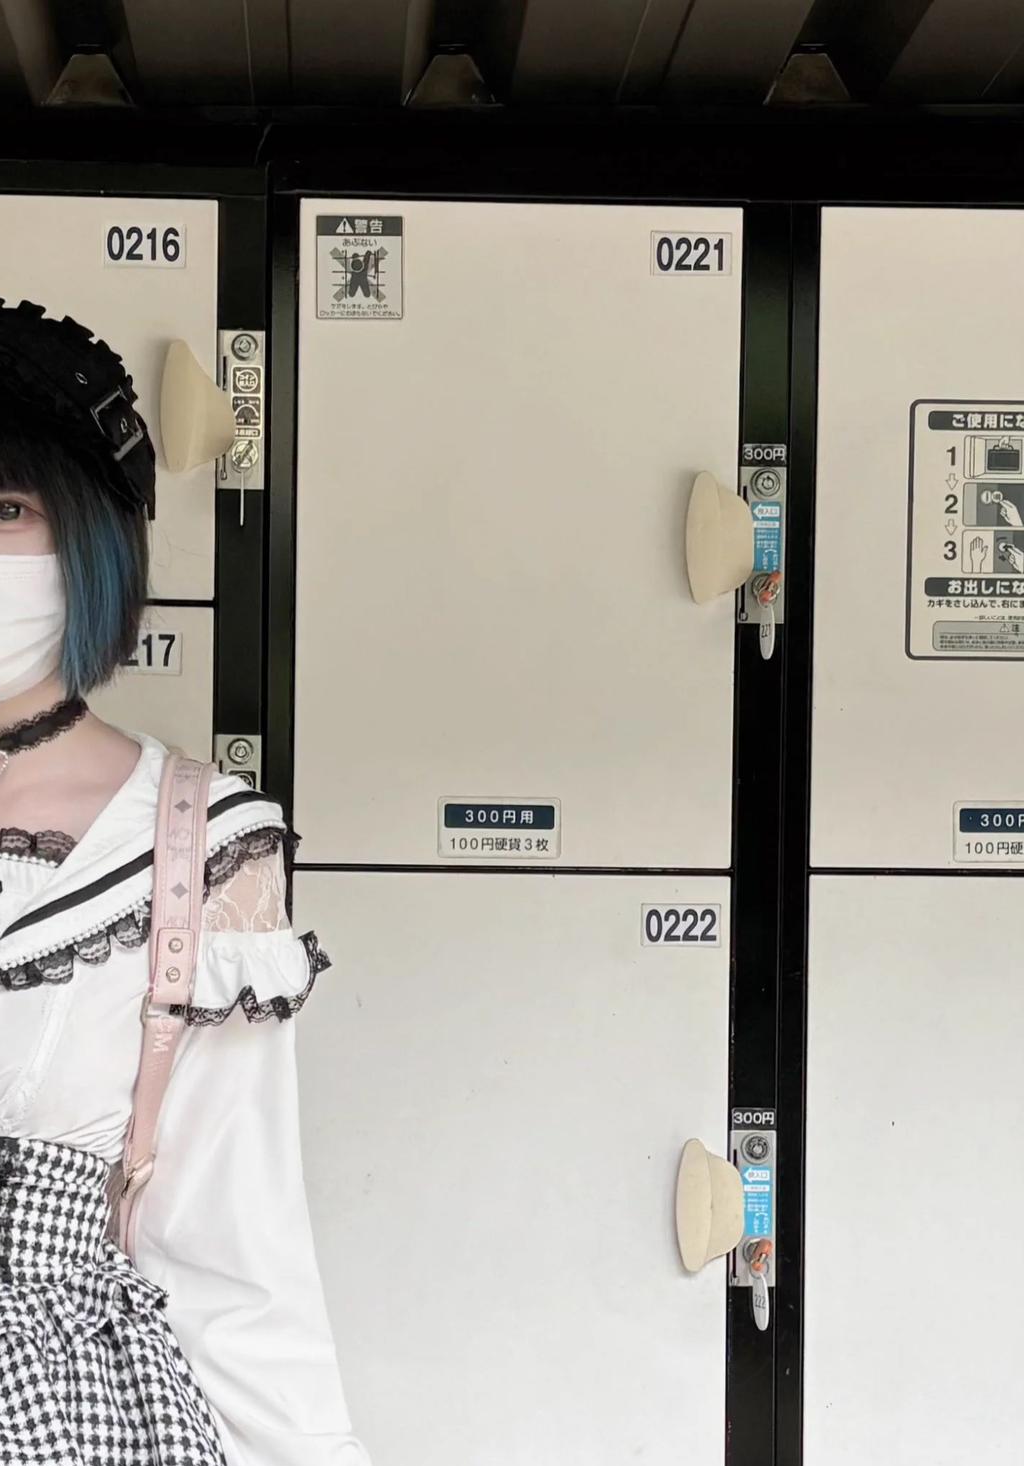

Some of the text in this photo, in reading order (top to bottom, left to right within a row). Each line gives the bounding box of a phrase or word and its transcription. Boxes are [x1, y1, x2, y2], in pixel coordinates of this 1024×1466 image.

[107, 226, 180, 262] 0216
[656, 236, 724, 271] 0221
[744, 446, 786, 462] 300円
[946, 446, 957, 466] 1
[944, 494, 959, 514] 2
[943, 541, 957, 561] 3
[120, 634, 175, 667] 17
[465, 810, 534, 824] 300円用
[450, 837, 549, 852] 100円硬貨3枚
[645, 908, 717, 942] 0222
[733, 1110, 775, 1125] 300円
